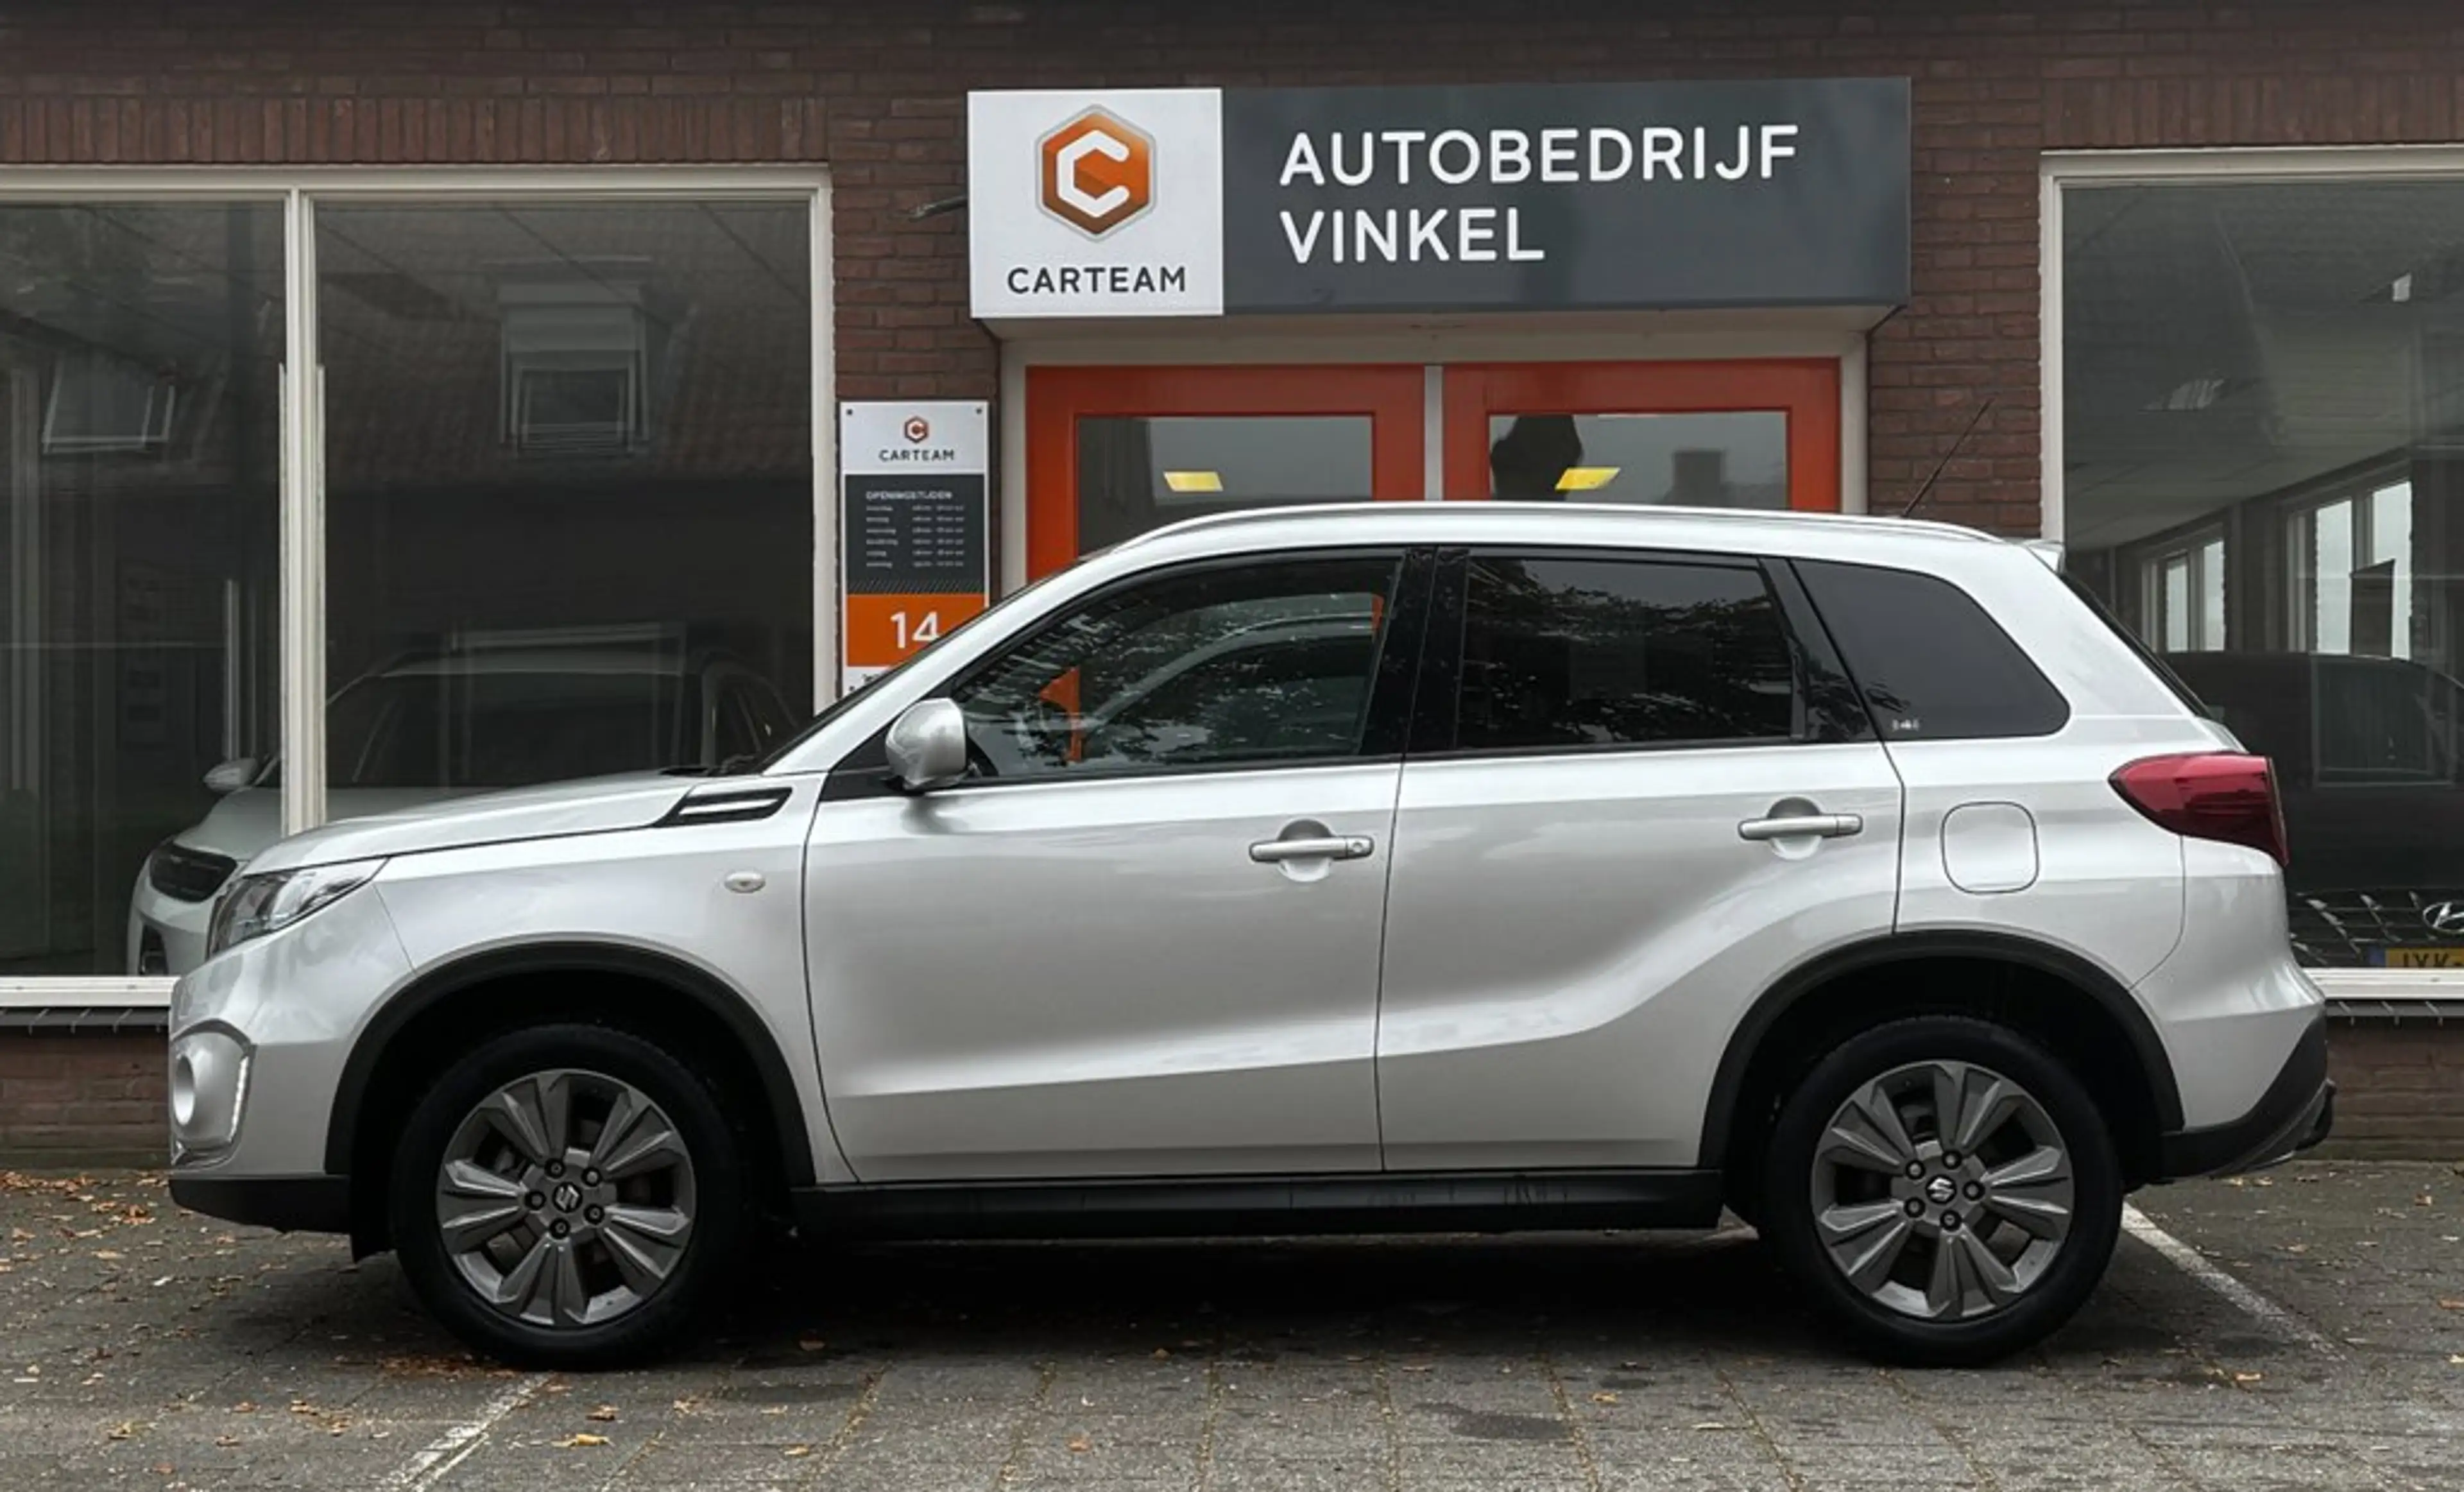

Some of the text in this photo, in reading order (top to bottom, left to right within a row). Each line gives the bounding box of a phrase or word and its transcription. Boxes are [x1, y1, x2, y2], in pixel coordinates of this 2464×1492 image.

[1279, 124, 1799, 186] AUTOBEDRIJF
[1279, 207, 1545, 264] VINKEL
[1007, 266, 1186, 295] CARTEAM
[878, 449, 955, 462] CARTEAM
[890, 611, 940, 649] 14
